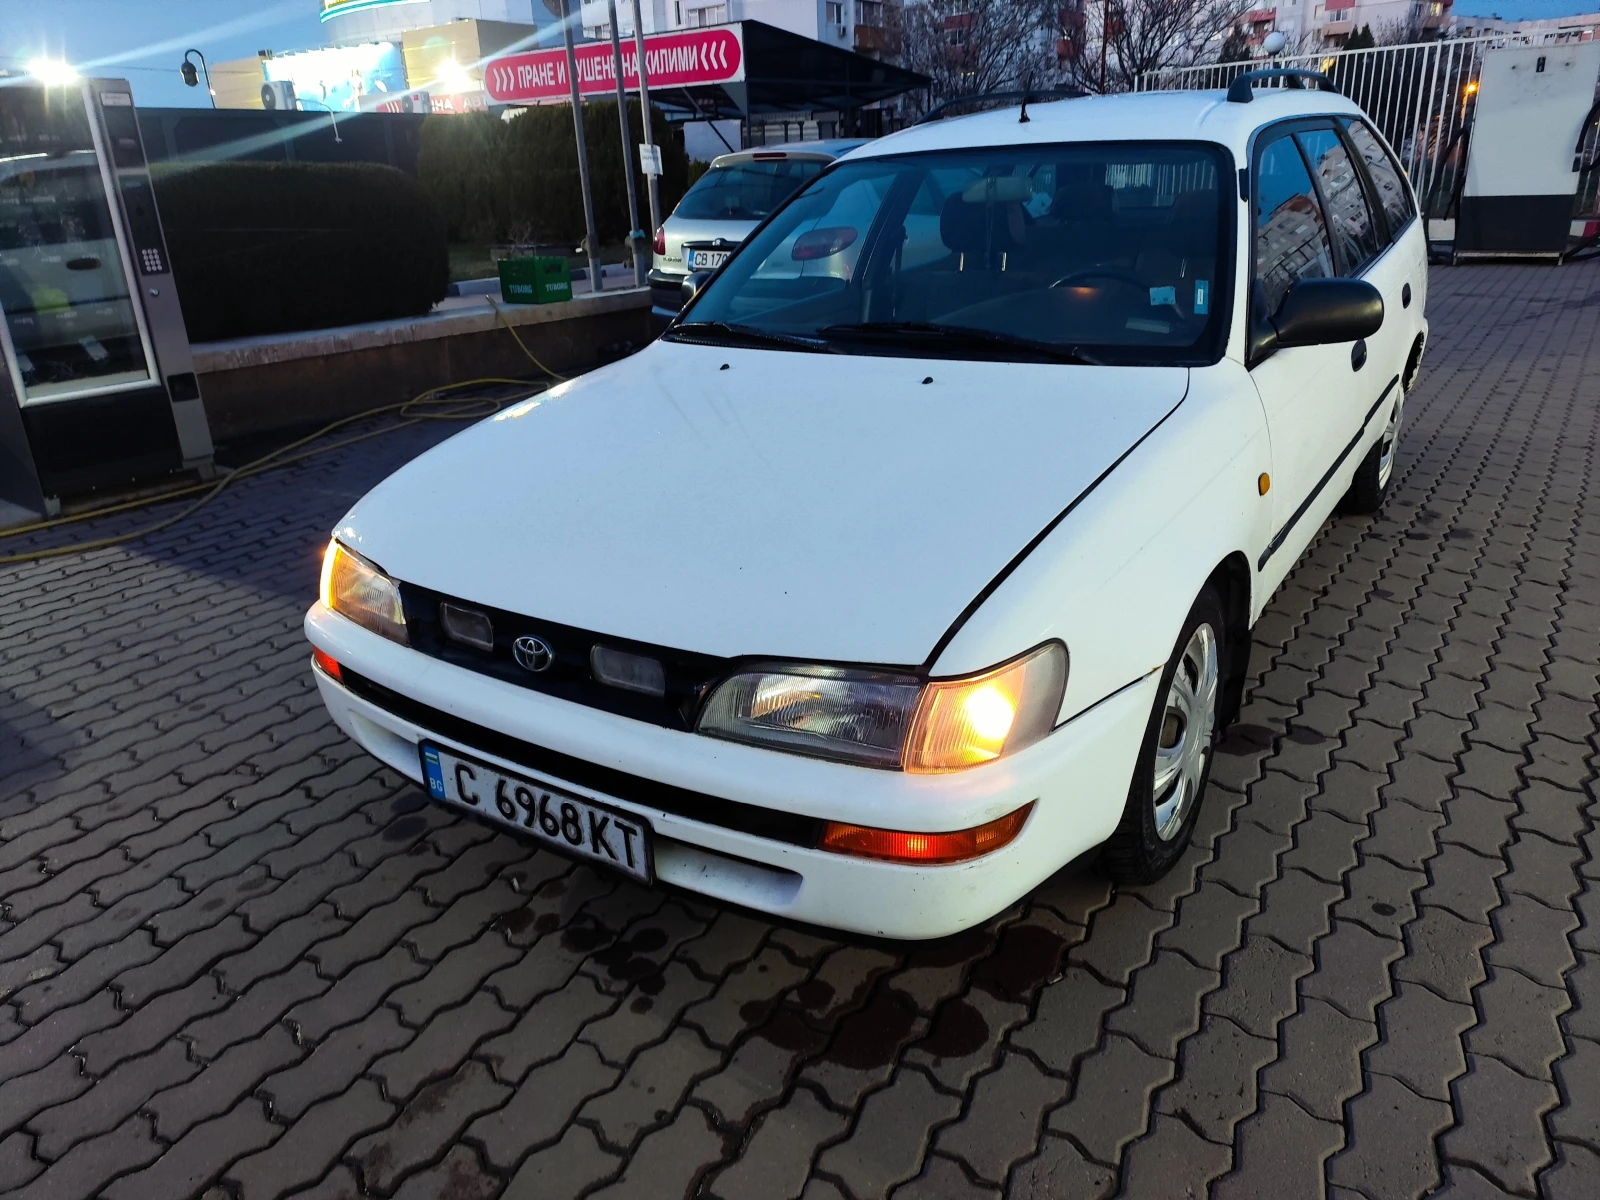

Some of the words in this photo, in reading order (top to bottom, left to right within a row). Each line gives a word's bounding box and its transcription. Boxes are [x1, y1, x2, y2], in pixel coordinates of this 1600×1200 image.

[517, 64, 556, 89] ПРАНЕ
[557, 61, 566, 85] И
[621, 52, 640, 78] НА
[695, 253, 708, 266] CB
[509, 284, 533, 294] TUBORG
[545, 281, 569, 292] TUBORG
[430, 776, 443, 792] BG
[455, 763, 480, 806] C
